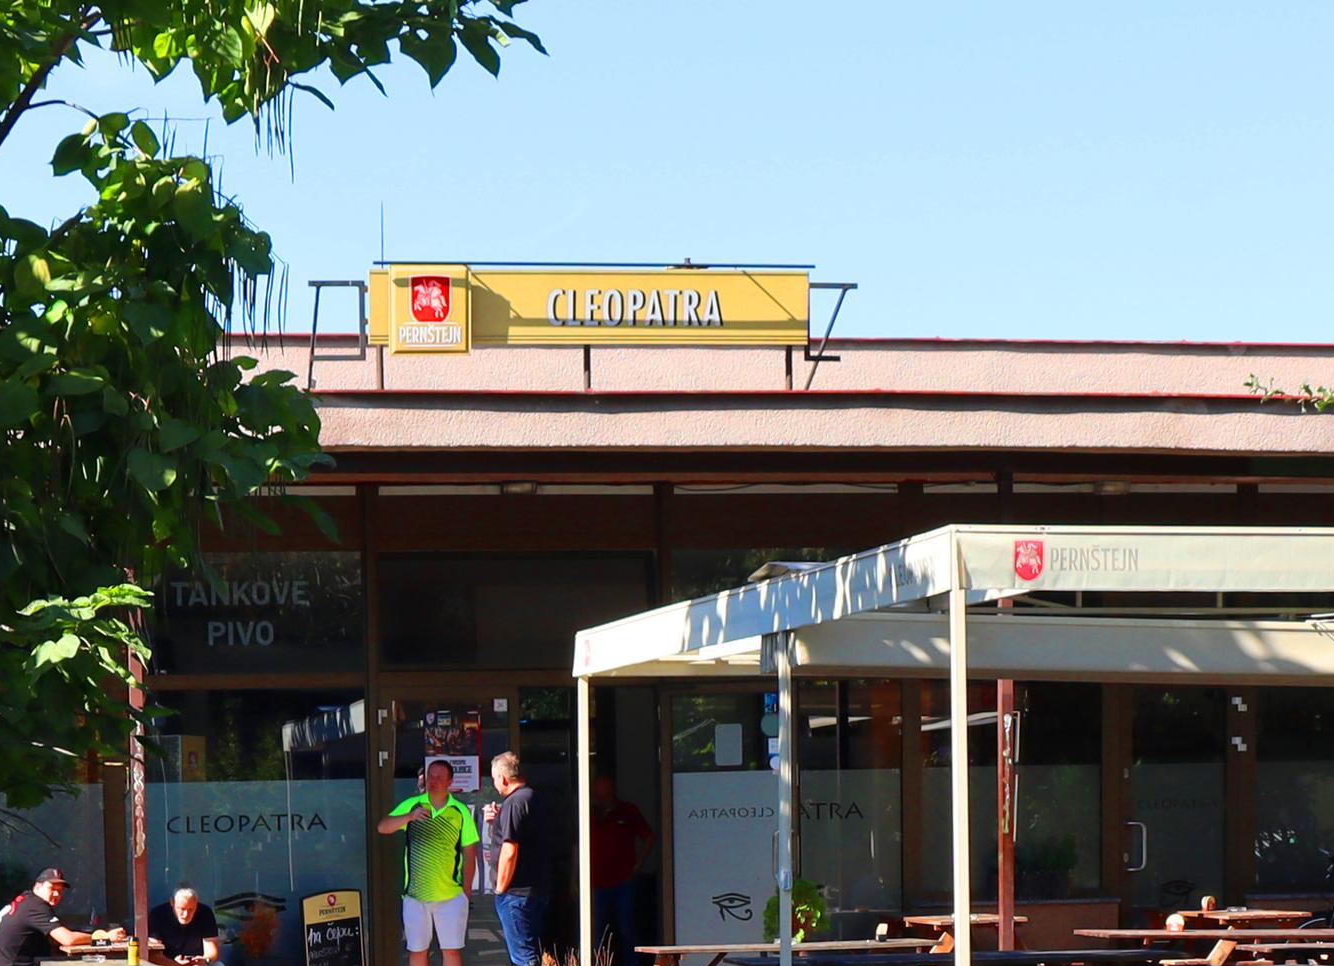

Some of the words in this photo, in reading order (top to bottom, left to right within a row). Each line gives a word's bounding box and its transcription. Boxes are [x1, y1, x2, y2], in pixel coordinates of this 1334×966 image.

[546, 287, 725, 327] CLEOPATRA
[398, 323, 463, 344] PERNŠTEJN
[1049, 544, 1140, 572] PERNŠTEJN
[207, 620, 275, 647] PIVO
[166, 813, 328, 834] CLEOPATRA
